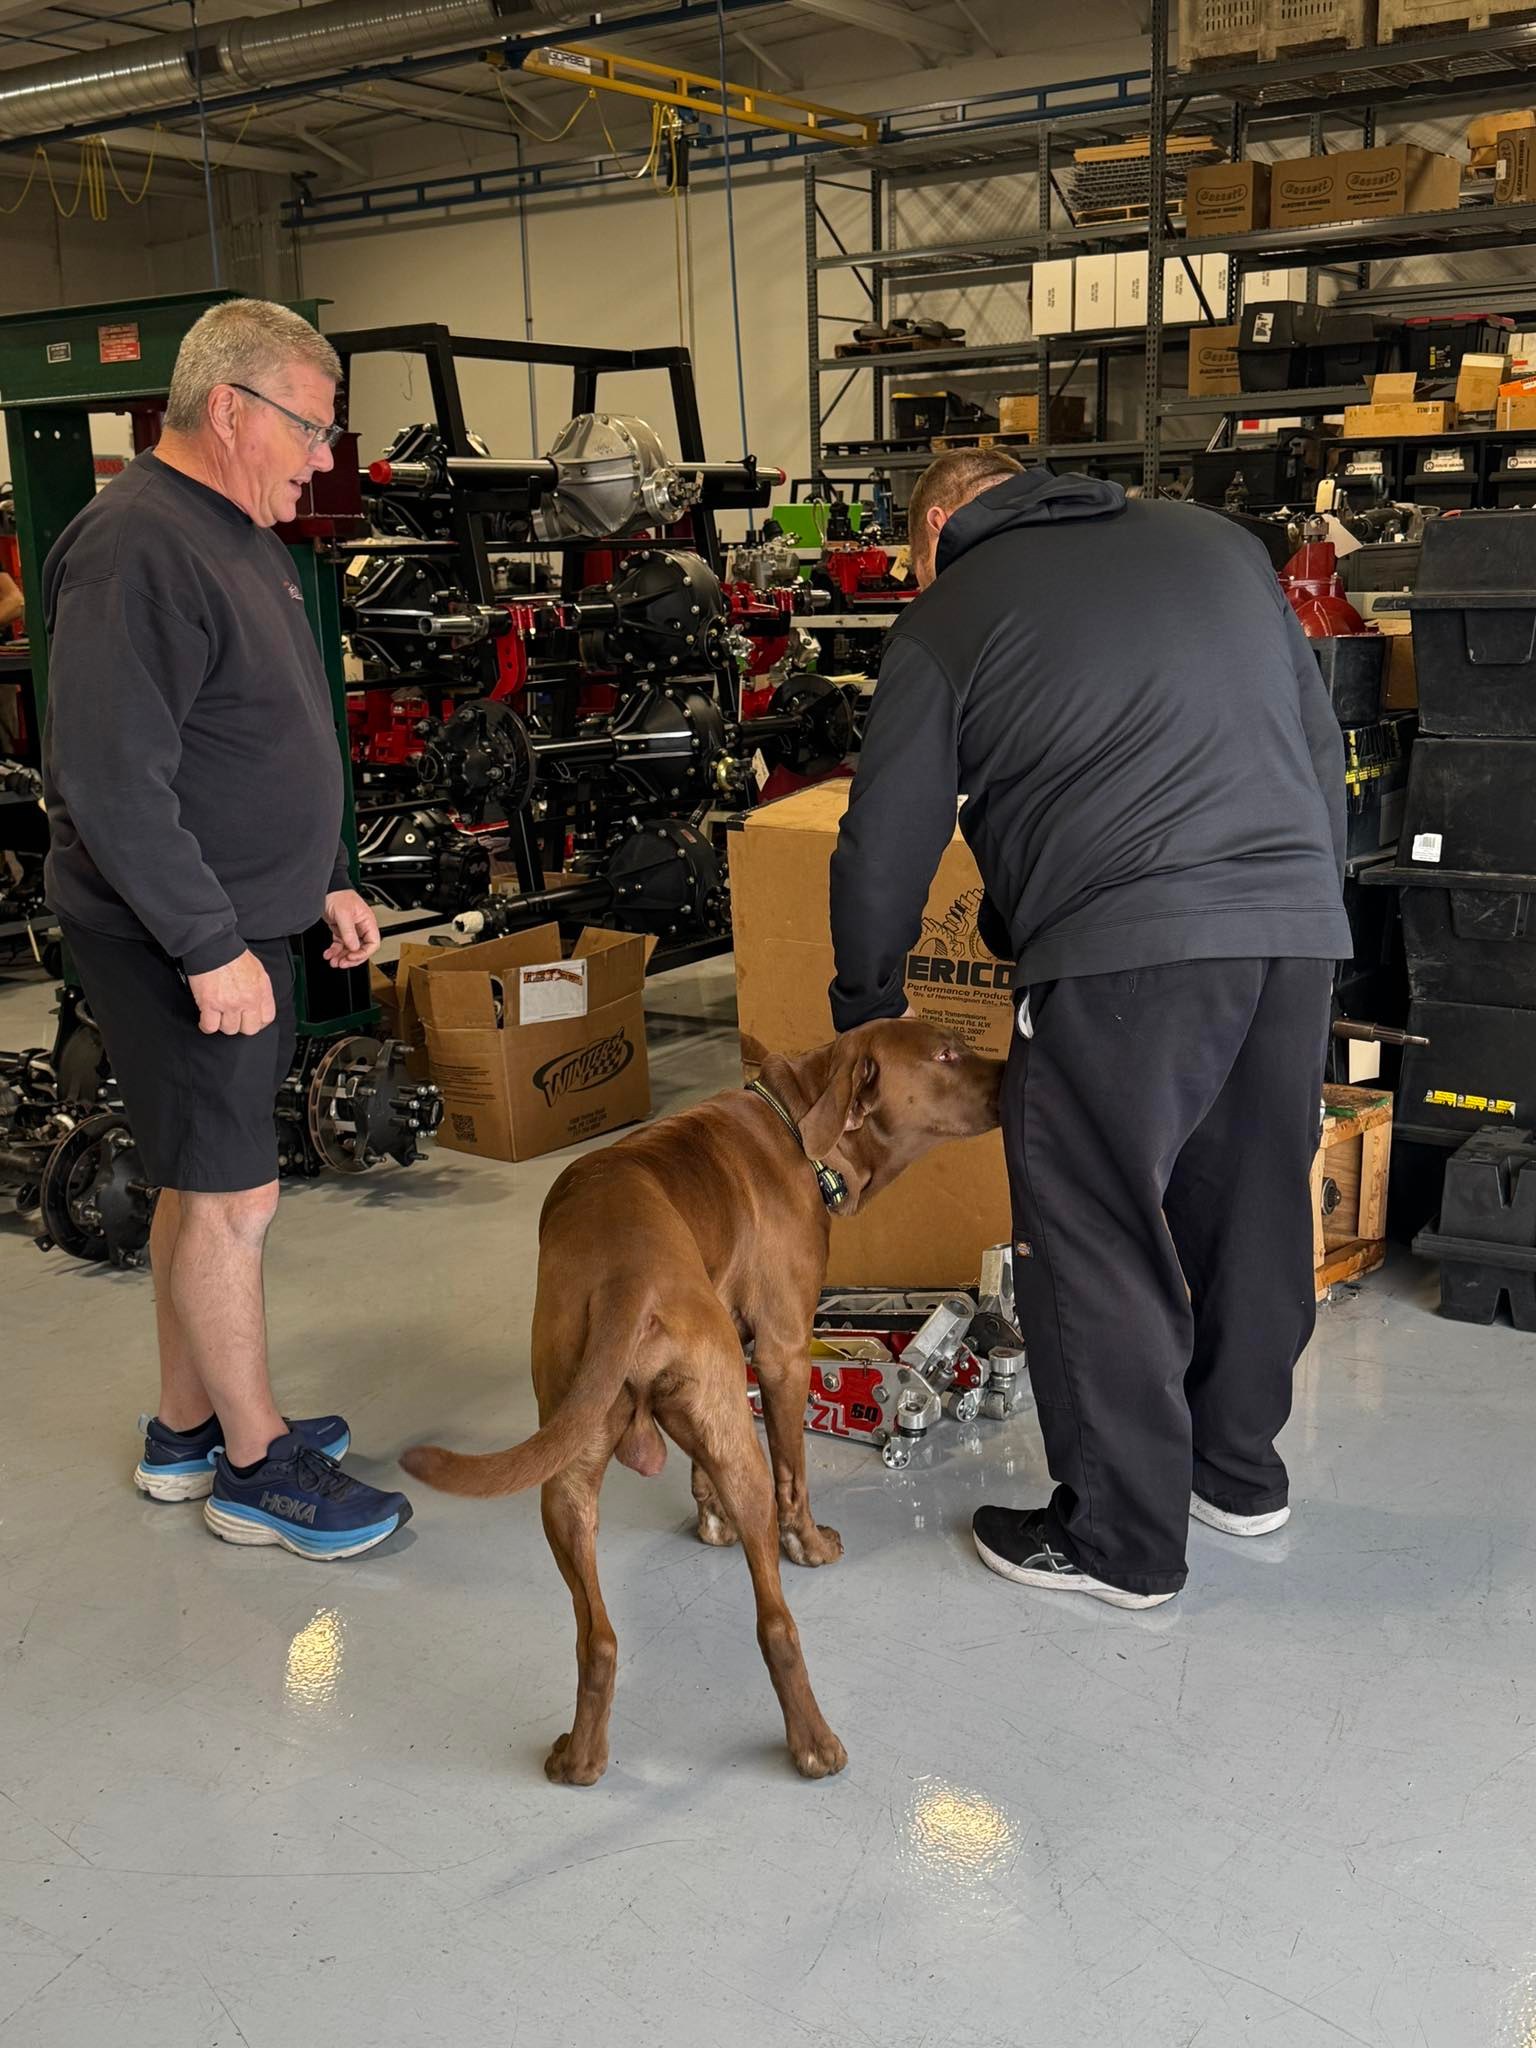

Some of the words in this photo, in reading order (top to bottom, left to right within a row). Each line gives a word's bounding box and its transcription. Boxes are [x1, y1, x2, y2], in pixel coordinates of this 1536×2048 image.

[549, 50, 591, 68] GORBEL
[1416, 406, 1440, 414] TIMEN
[906, 982, 971, 997] Performance
[922, 1008, 943, 1016] Racing
[544, 1026, 626, 1108] WINTERS
[261, 1490, 317, 1525] HOKA
